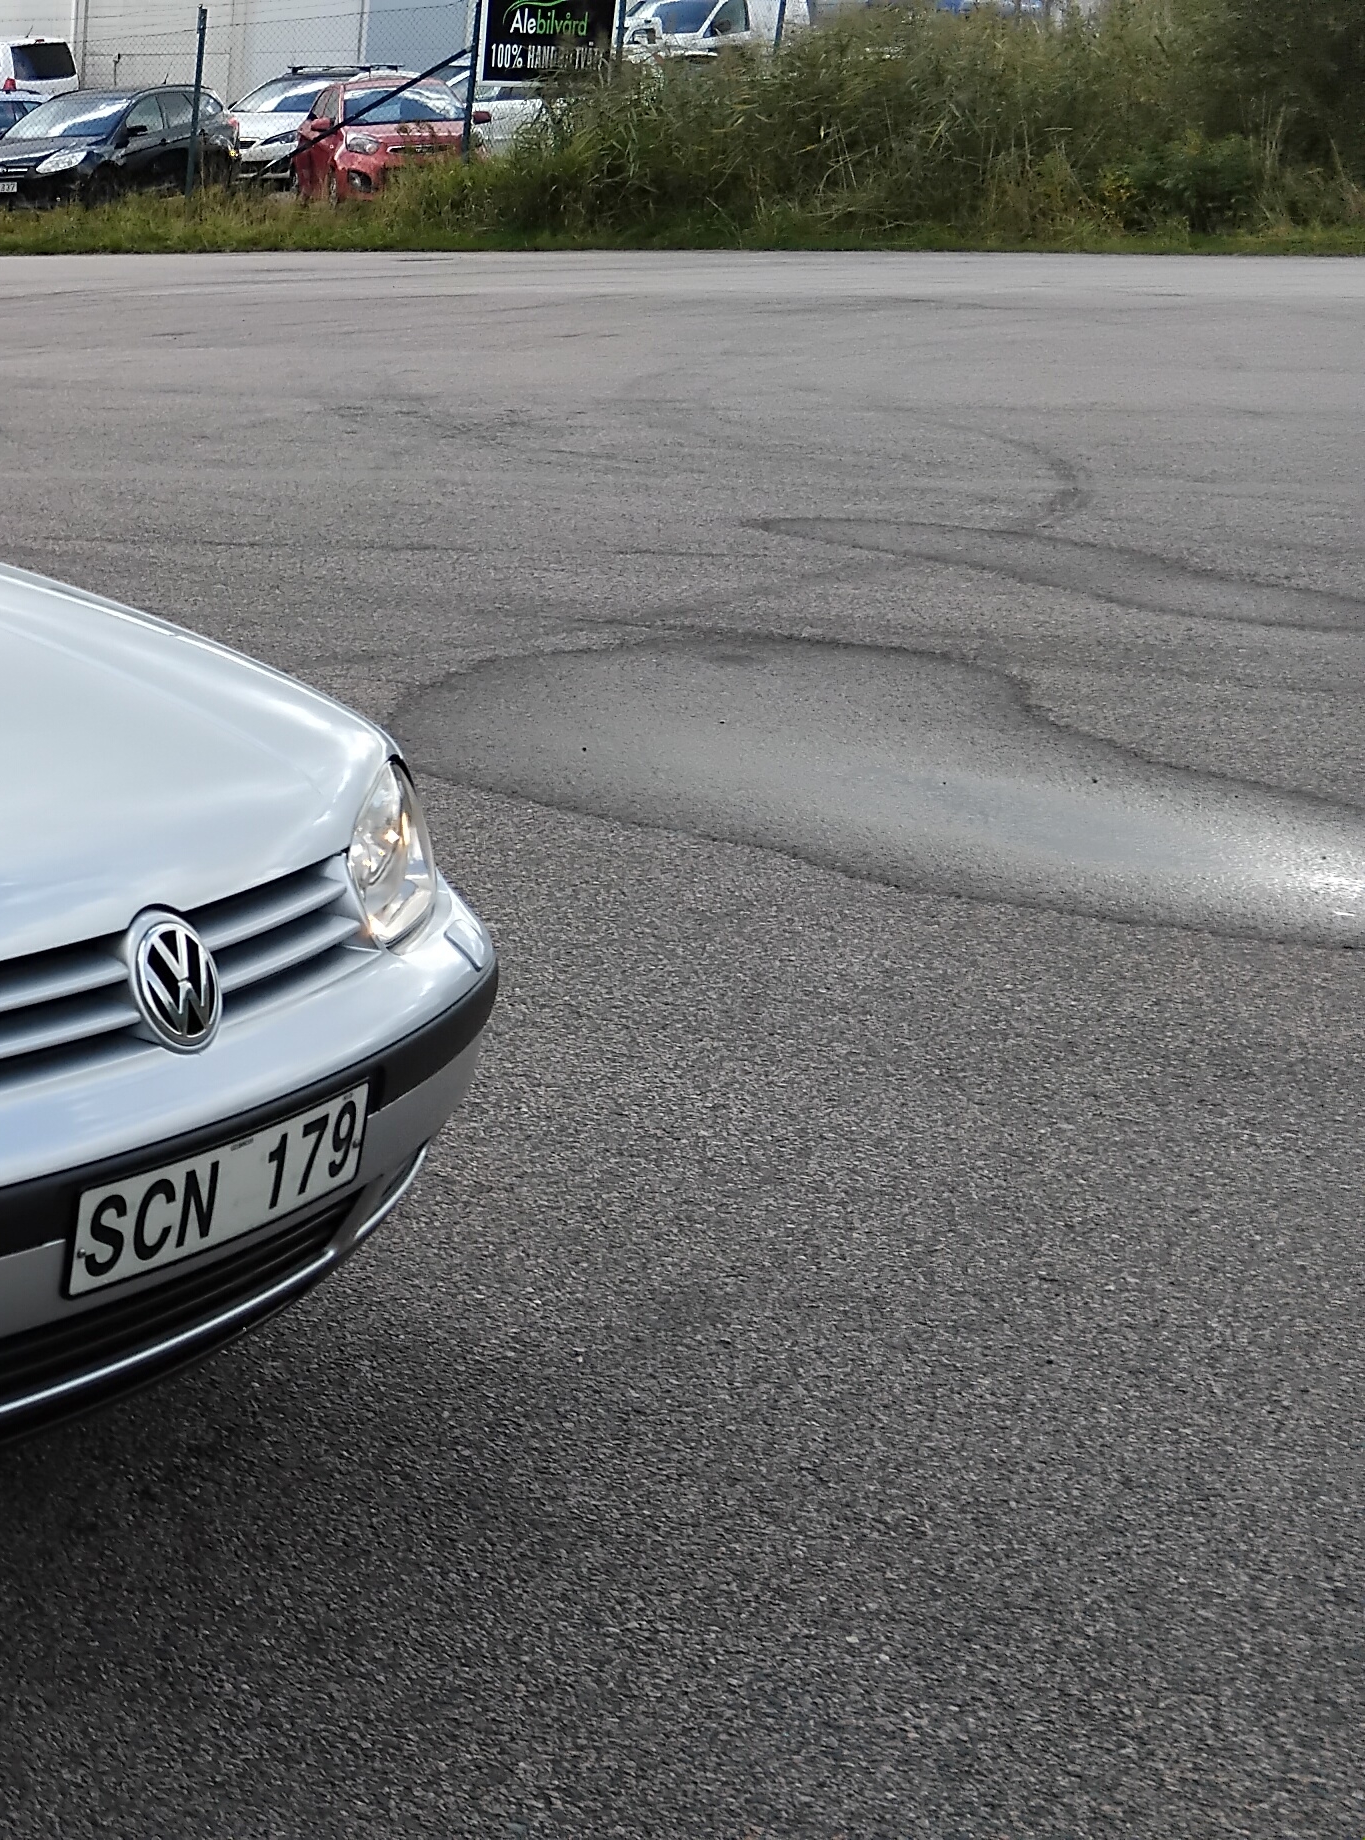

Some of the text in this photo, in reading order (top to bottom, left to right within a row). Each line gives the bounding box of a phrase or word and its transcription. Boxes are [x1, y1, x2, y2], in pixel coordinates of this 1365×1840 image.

[510, 8, 588, 36] Alebilvård
[491, 43, 523, 68] 100%
[84, 1100, 357, 1278] SCN 179
